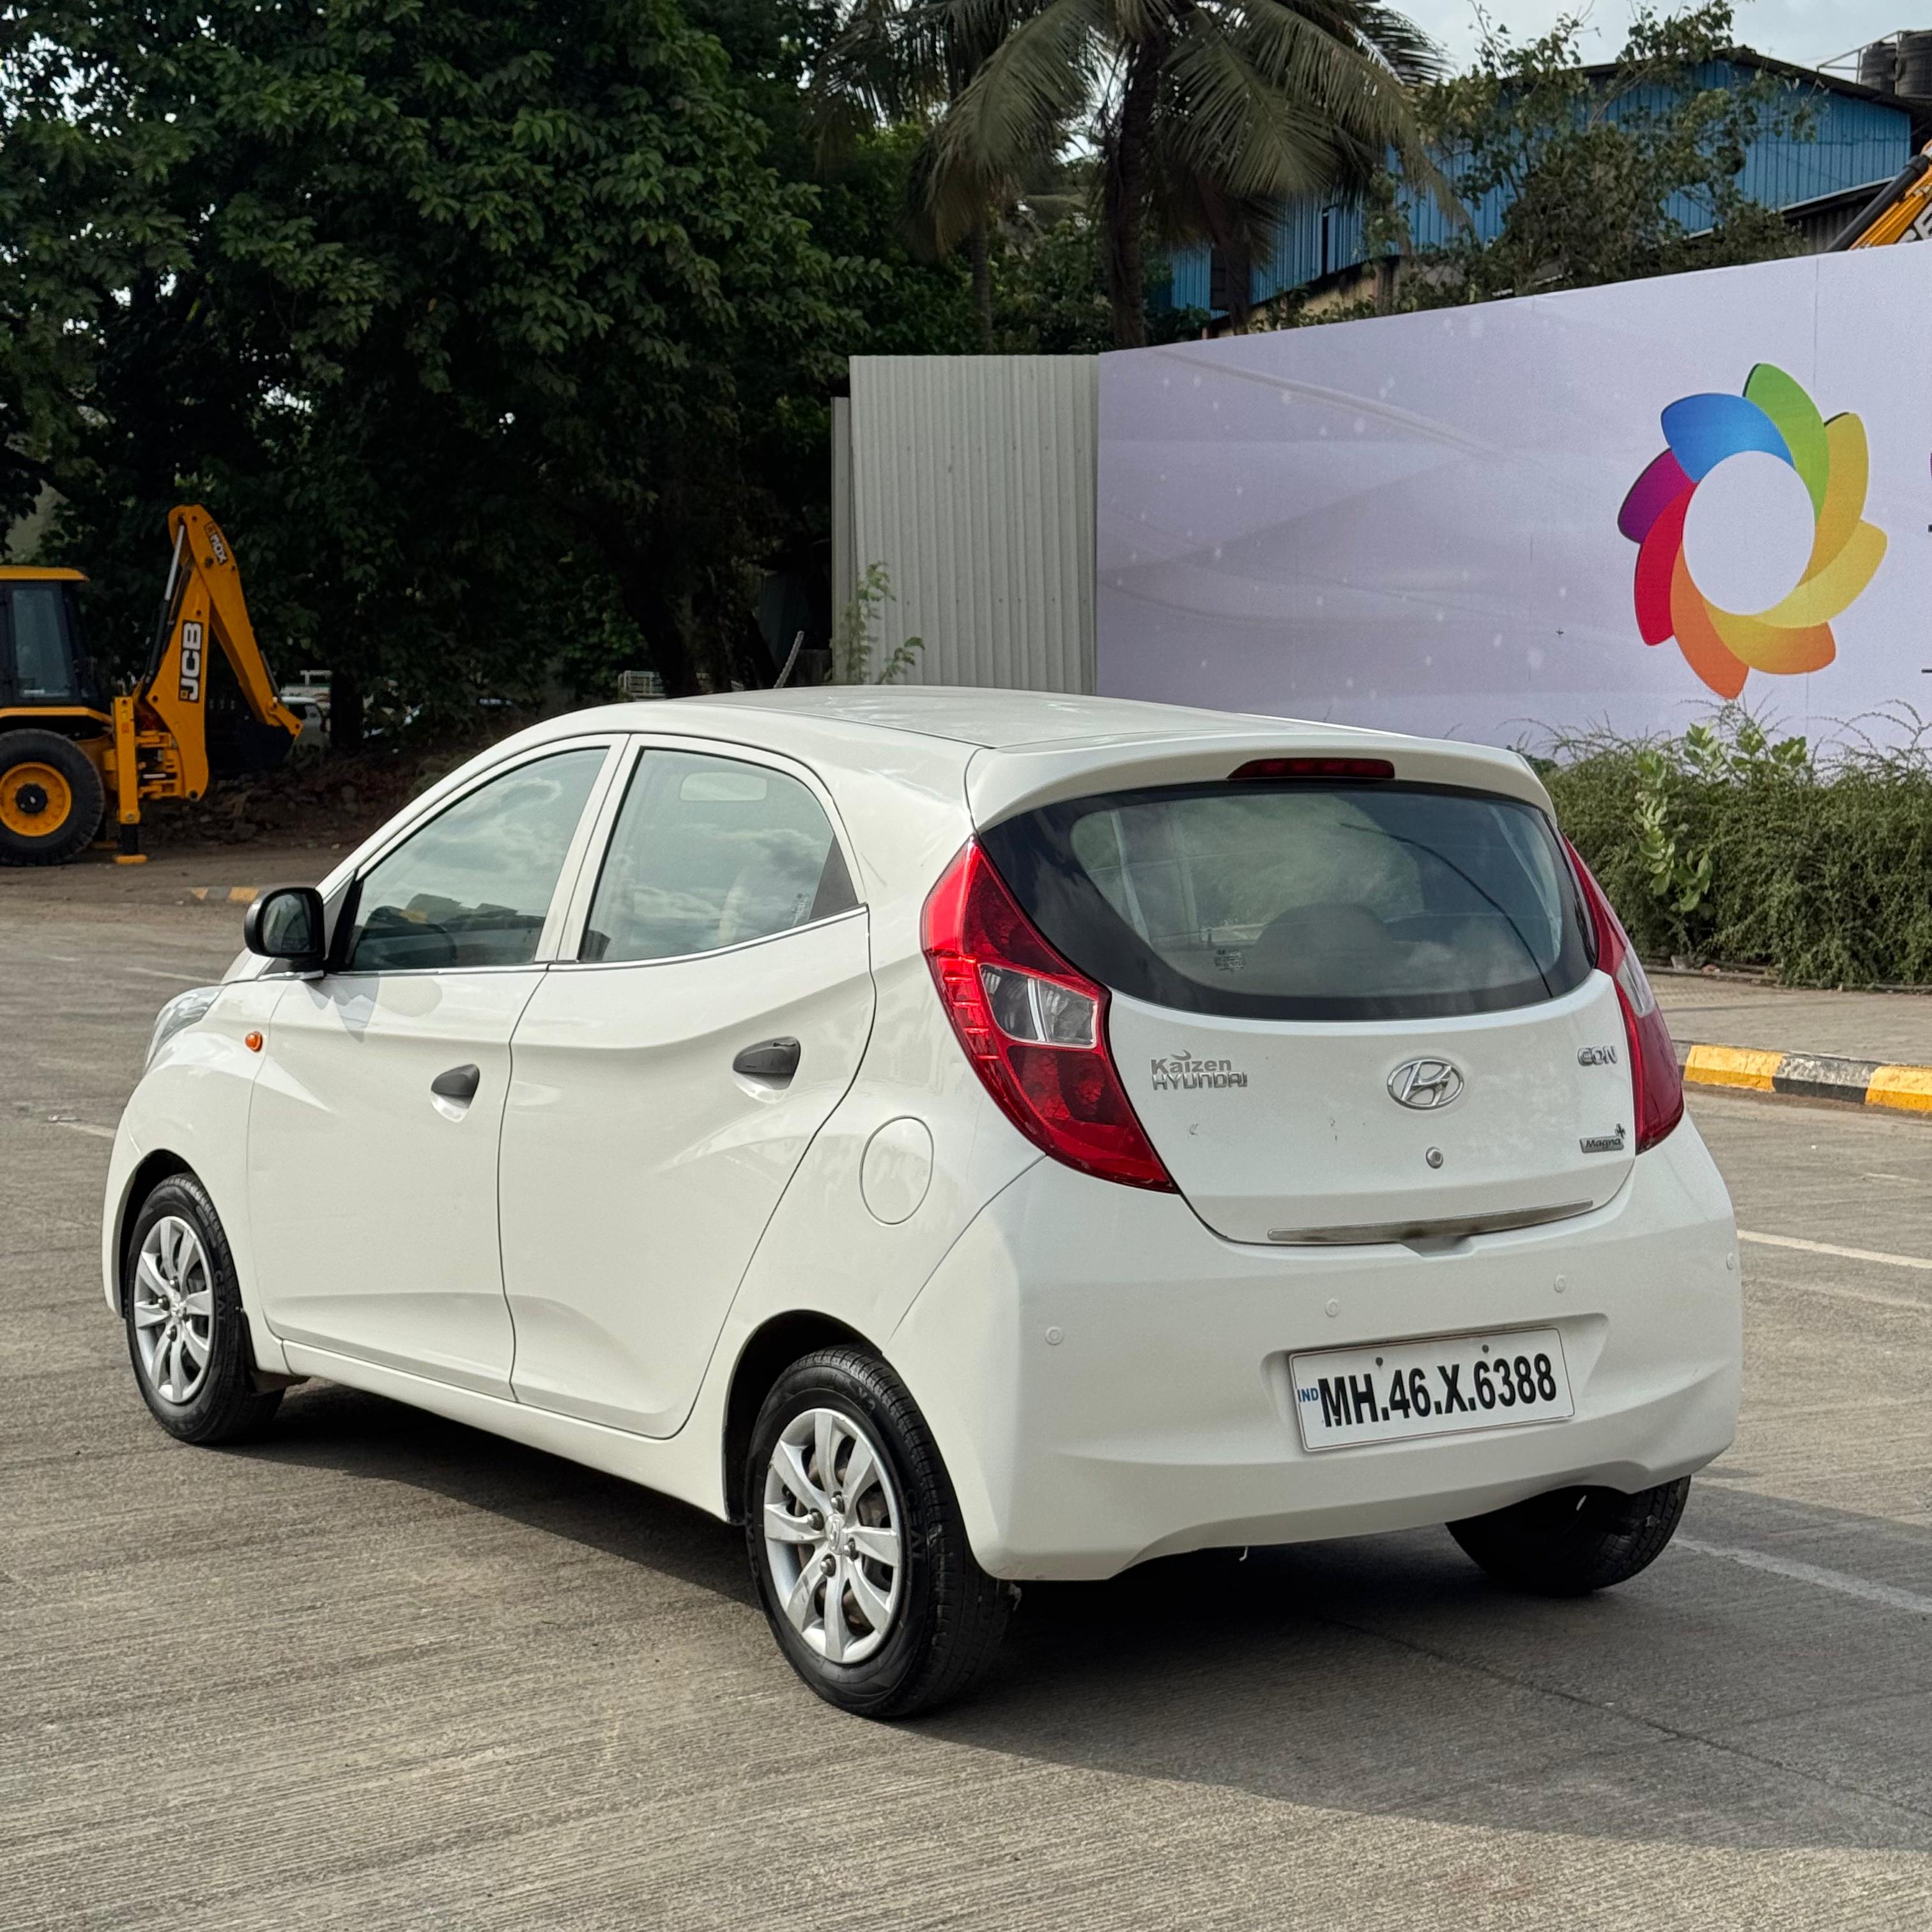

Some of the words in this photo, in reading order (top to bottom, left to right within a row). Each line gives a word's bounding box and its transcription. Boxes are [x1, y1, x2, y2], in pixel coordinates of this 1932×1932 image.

[181, 622, 202, 701] JCB
[1151, 1050, 1232, 1074] Kaizen
[1152, 1071, 1248, 1091] HYUNDAI
[1298, 1388, 1319, 1404] IND
[1317, 1353, 1556, 1428] MH.46.X.6388
